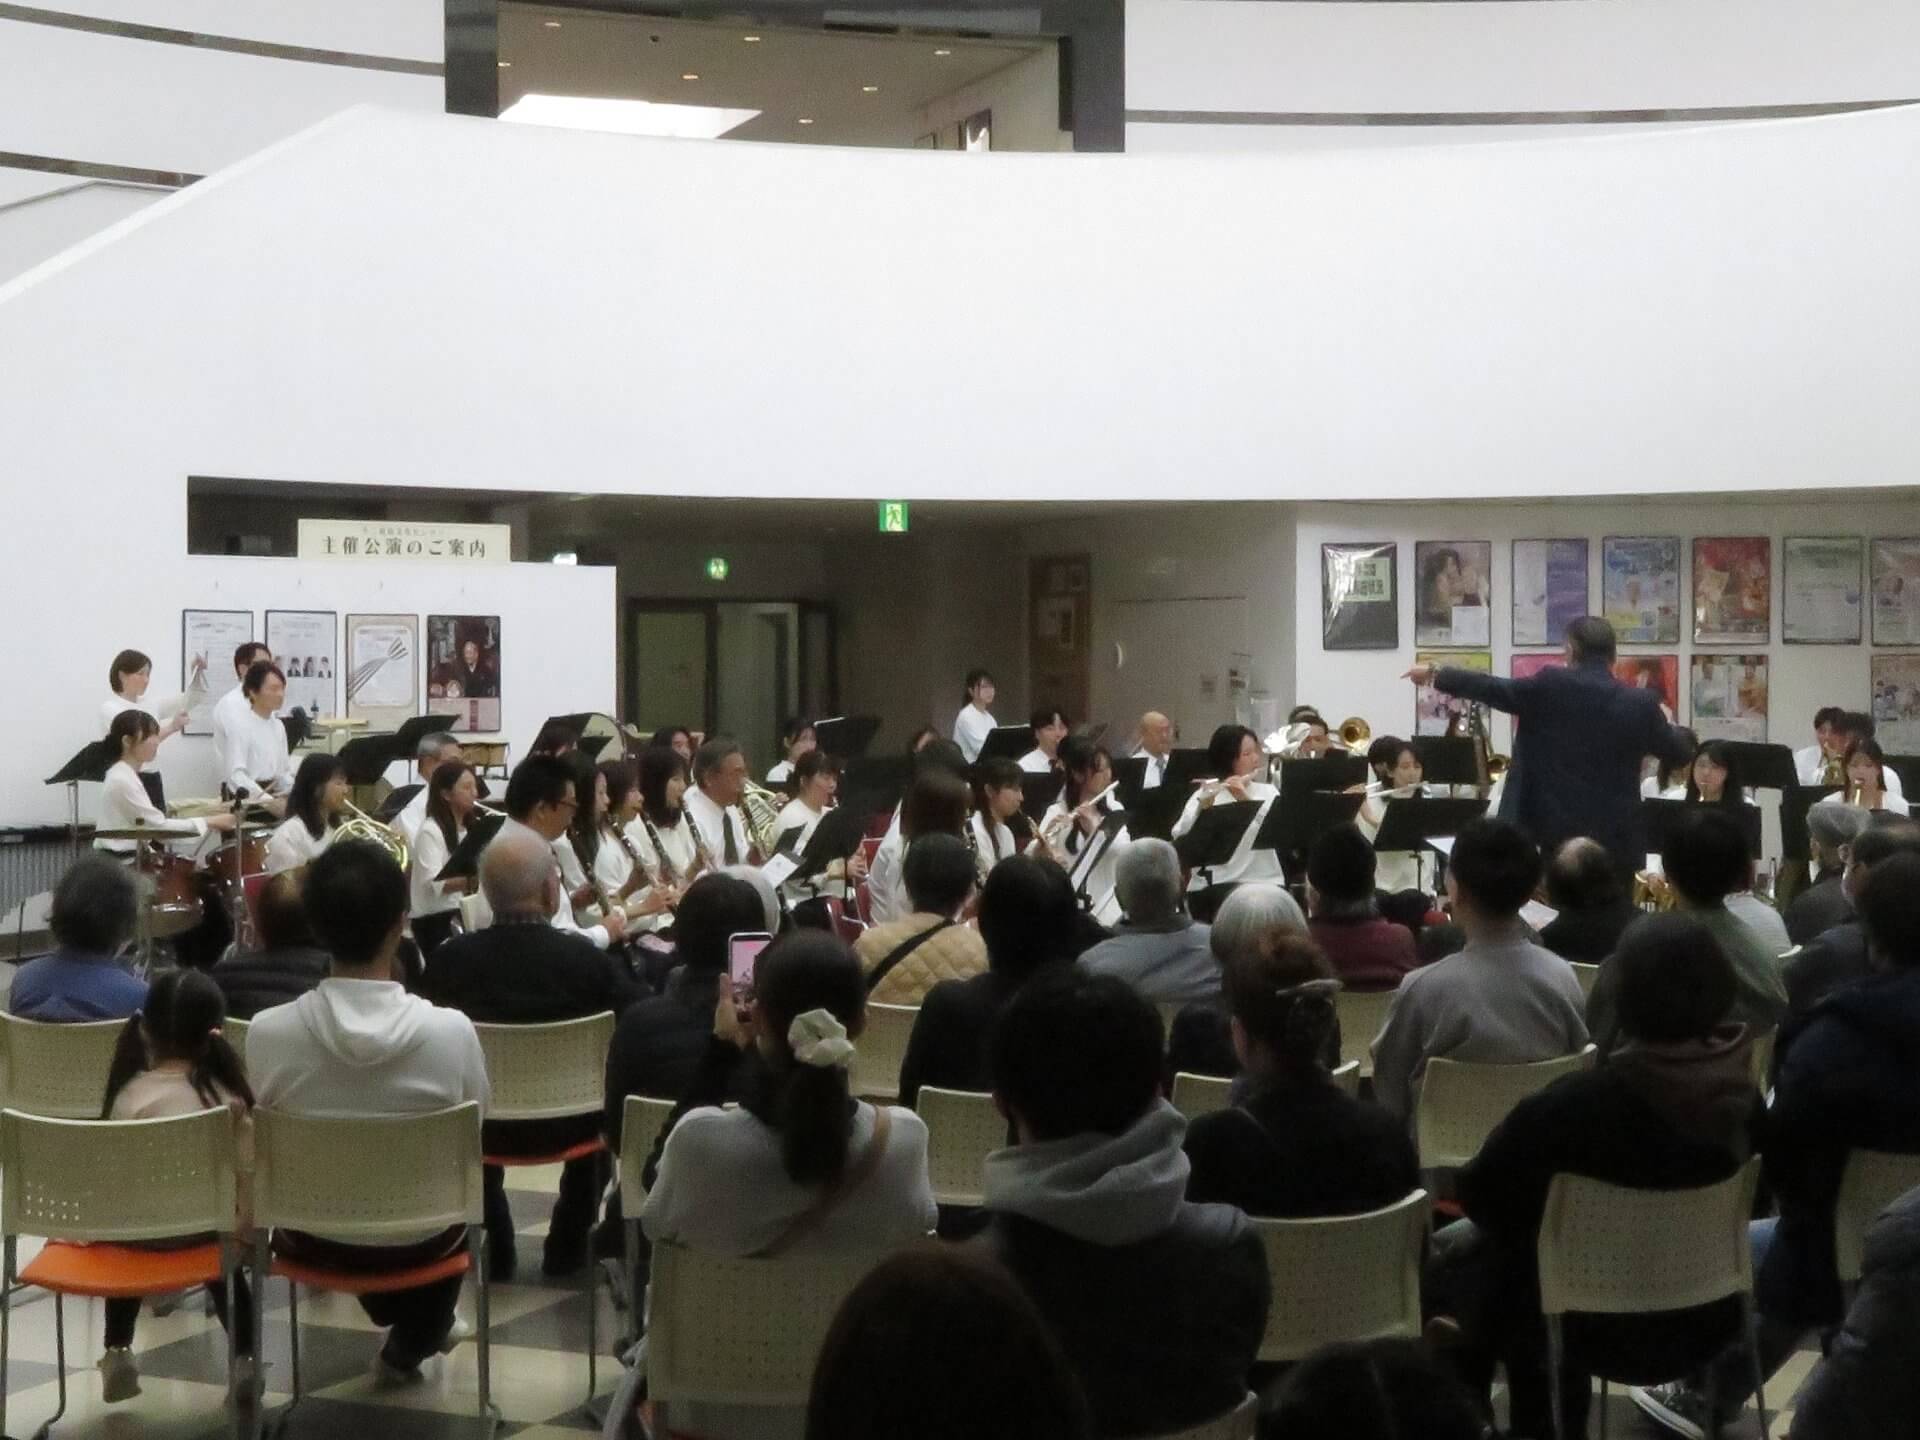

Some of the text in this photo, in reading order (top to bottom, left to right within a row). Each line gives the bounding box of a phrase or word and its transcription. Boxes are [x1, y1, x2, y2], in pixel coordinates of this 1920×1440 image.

[321, 535, 486, 558] 主催公演のご案内
